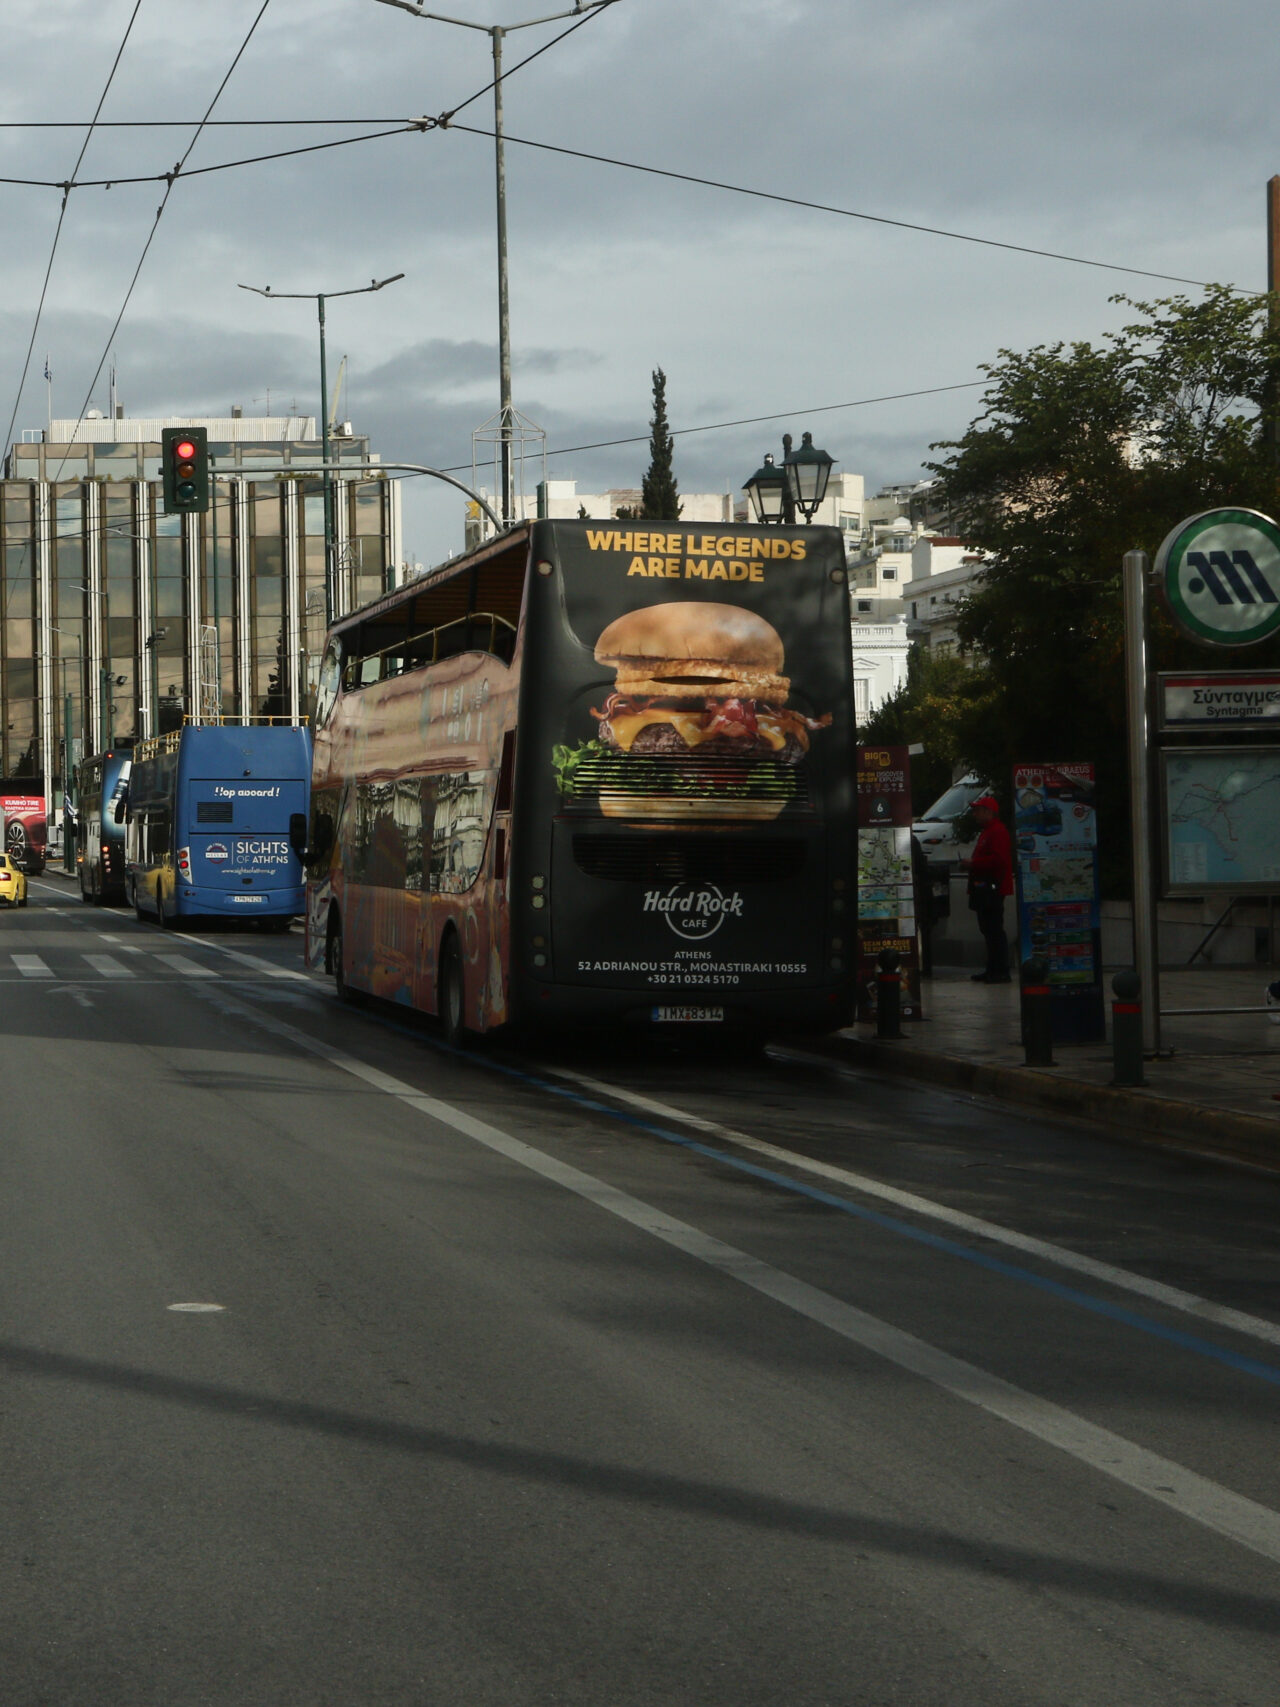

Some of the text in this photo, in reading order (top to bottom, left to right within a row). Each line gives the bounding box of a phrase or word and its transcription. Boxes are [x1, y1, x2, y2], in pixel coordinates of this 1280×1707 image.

[586, 530, 806, 560] WHERE LEGENDS
[627, 556, 765, 582] ARE MADE
[1206, 706, 1263, 718] Syntagma
[864, 752, 879, 760] BIG
[877, 803, 883, 812] 6
[236, 841, 289, 854] SIGHTS
[237, 855, 289, 864] OF ATHENS
[643, 891, 744, 916] Hard Rock
[682, 919, 707, 928] CAFE
[674, 951, 712, 959] ATHENS
[578, 961, 807, 973] 52 ADRIANOU STR., MONASTIRAKI 10555
[647, 975, 667, 984] +30
[684, 975, 711, 984] 0324
[713, 975, 739, 984] 5170
